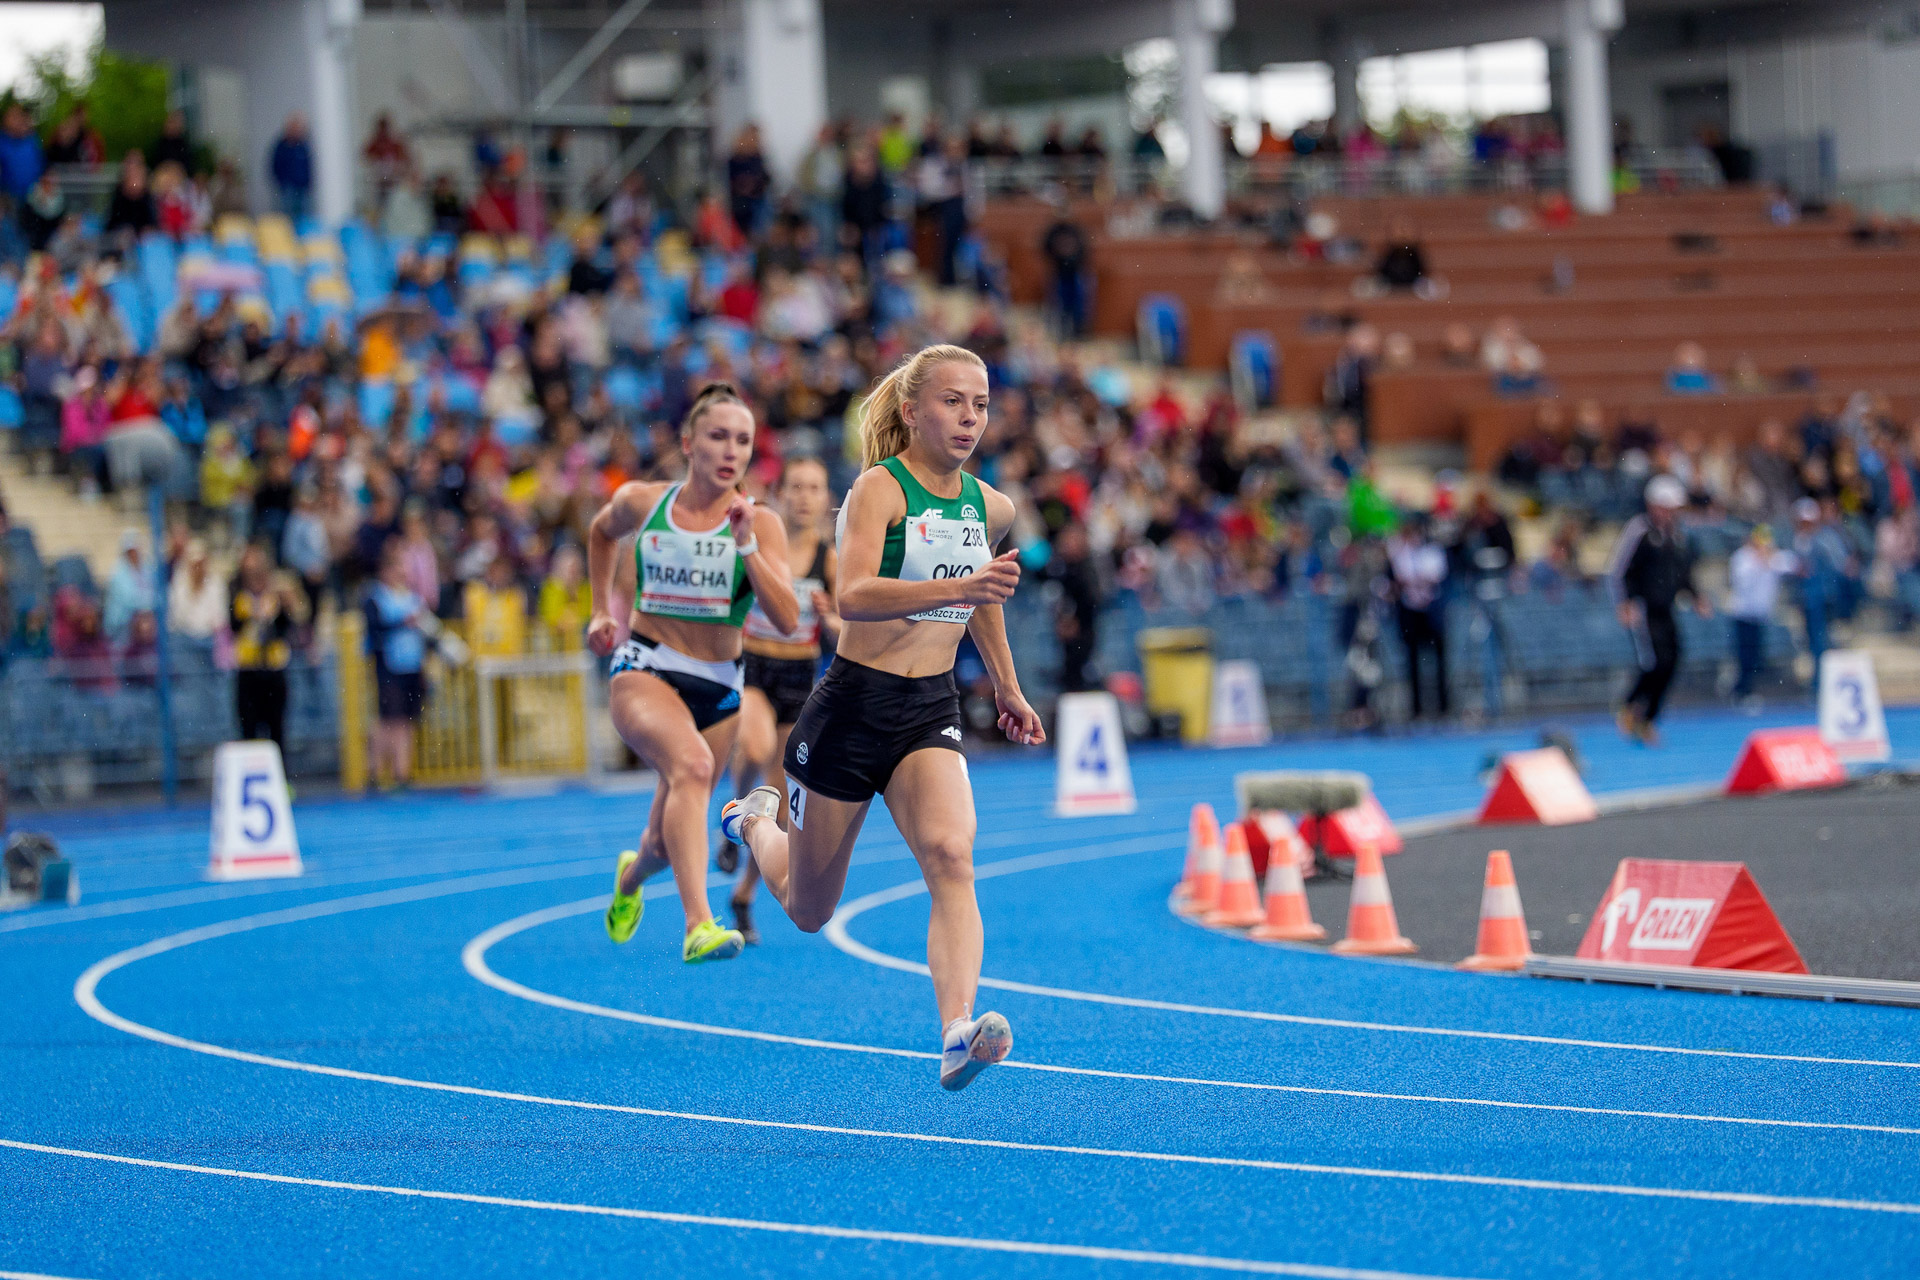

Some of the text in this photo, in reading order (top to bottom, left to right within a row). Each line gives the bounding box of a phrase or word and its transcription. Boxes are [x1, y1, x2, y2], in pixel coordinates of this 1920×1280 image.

[694, 541, 727, 558] 117
[963, 527, 983, 547] 238
[646, 563, 728, 588] TARACHA
[1836, 671, 1868, 736] 3
[1076, 724, 1108, 778] 4
[242, 773, 275, 843] 5
[790, 787, 801, 822] 4
[1639, 907, 1705, 940] ORLEN
